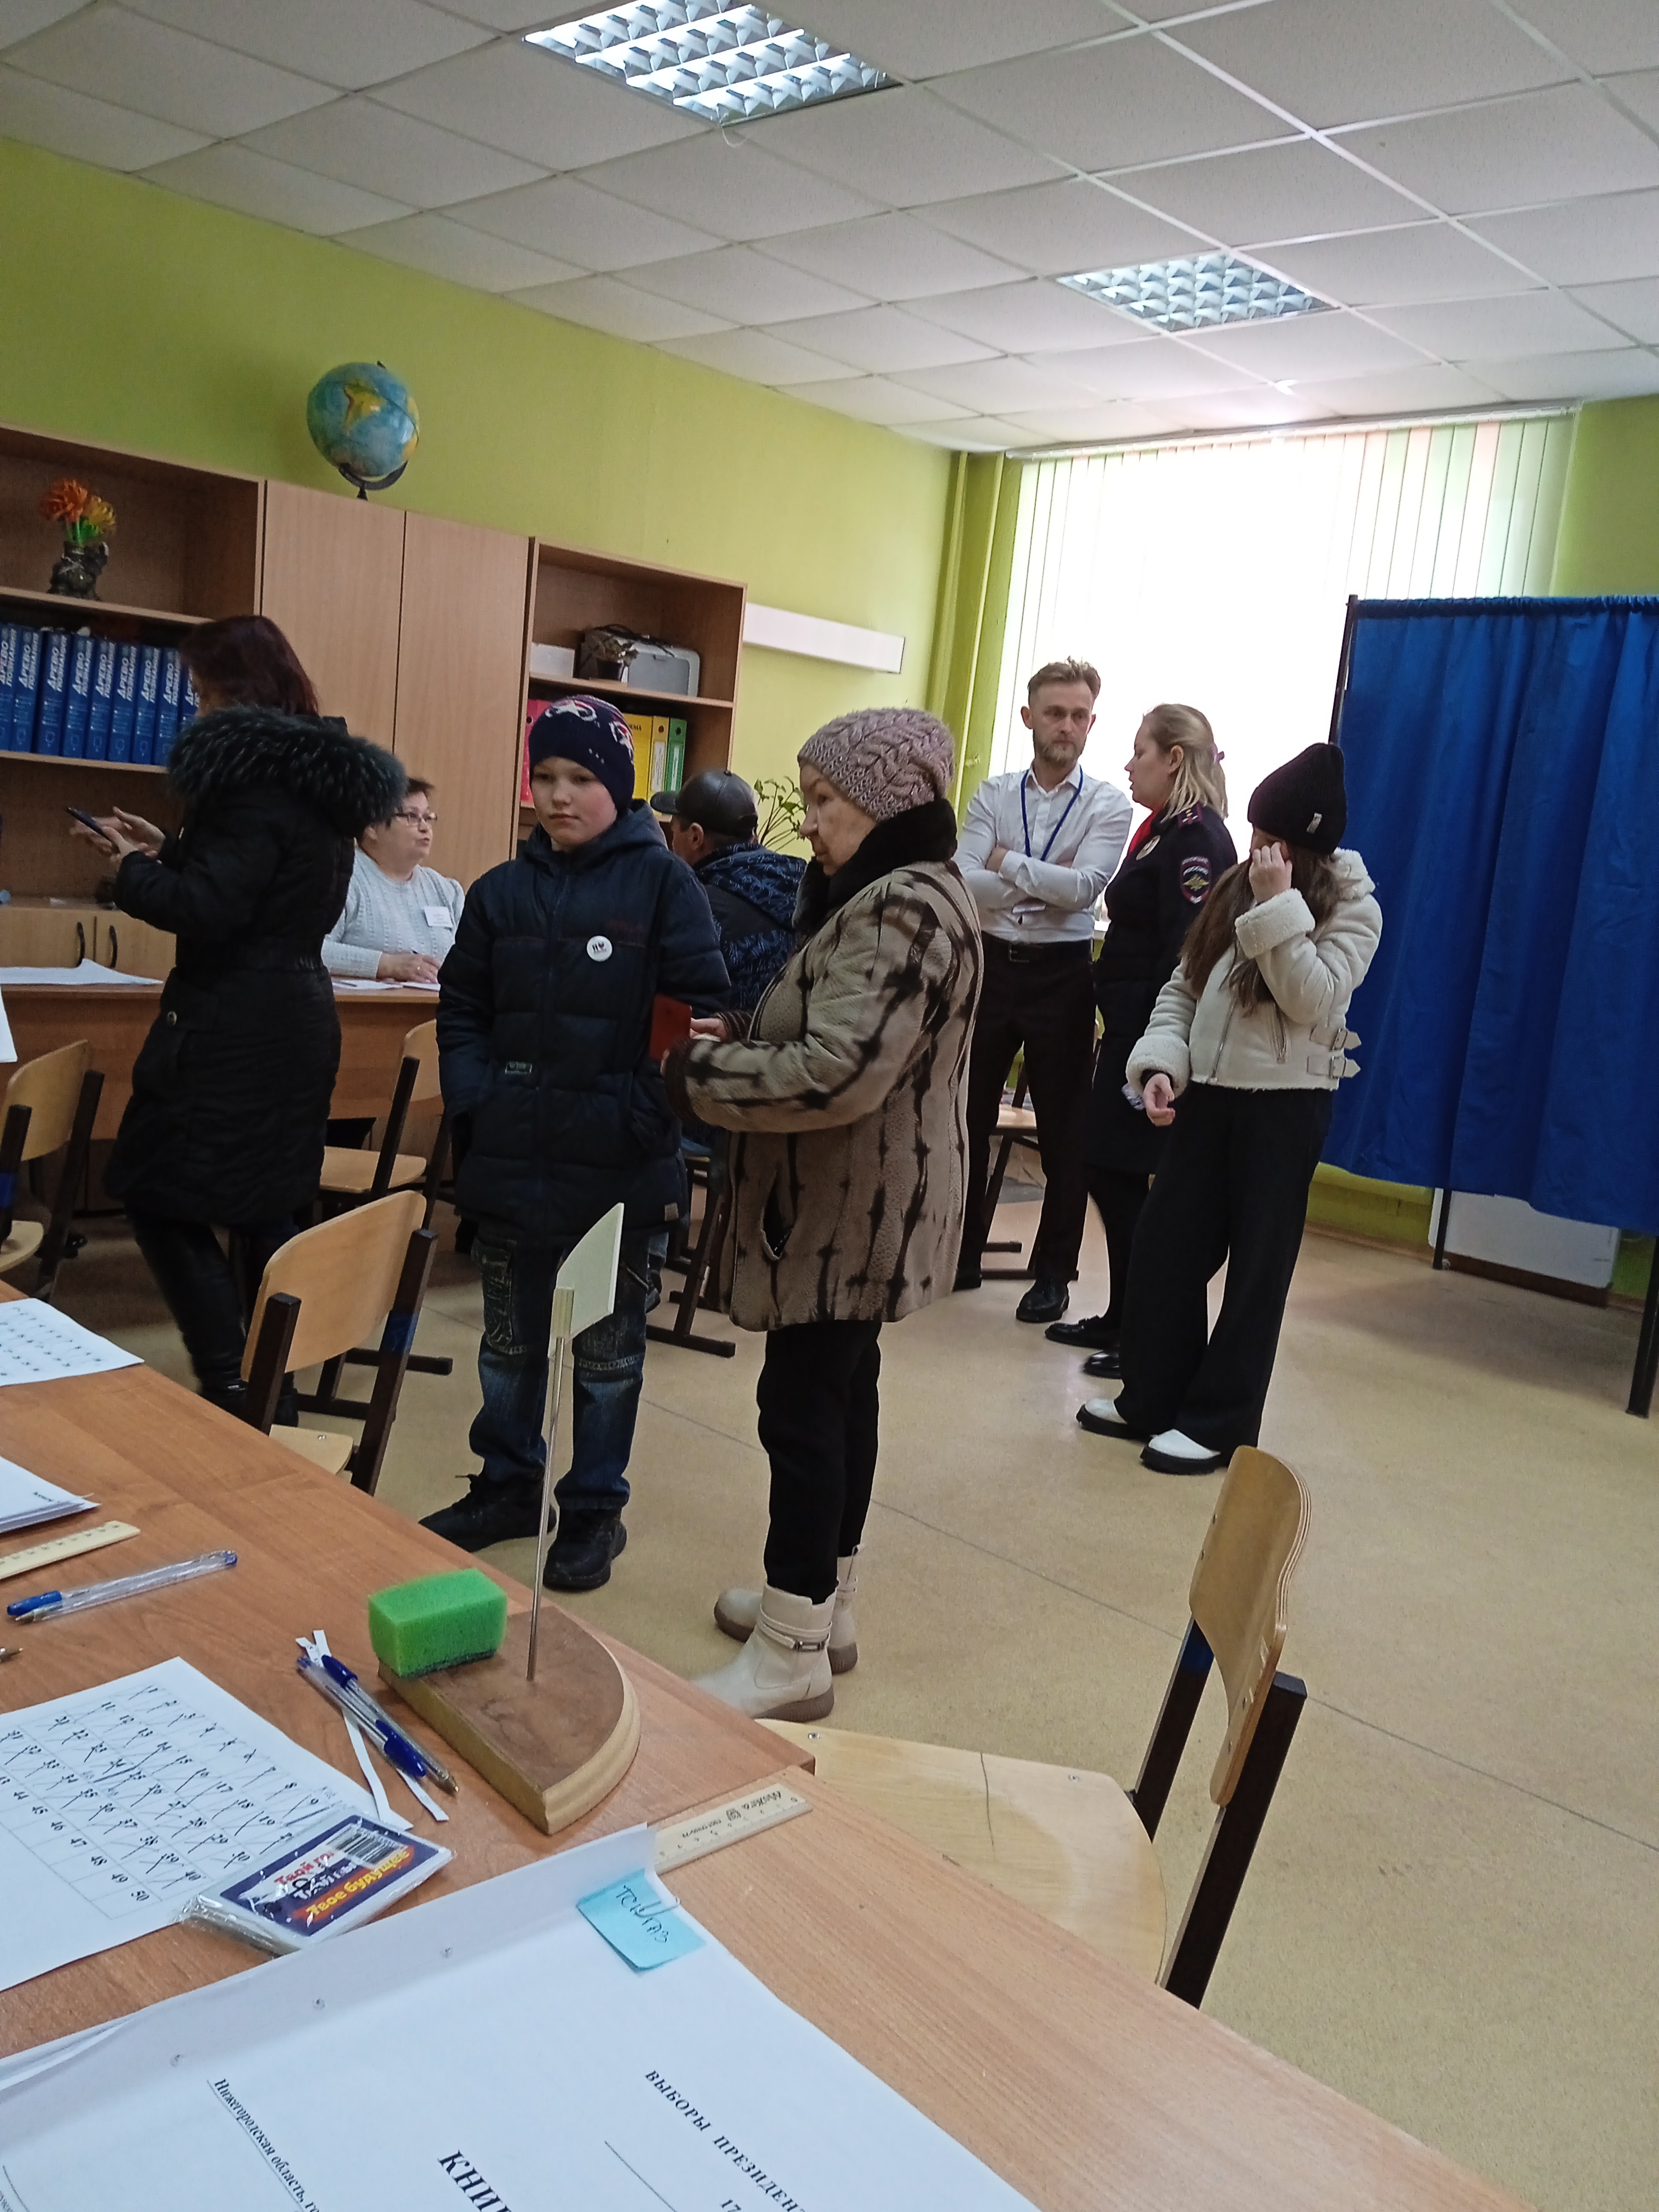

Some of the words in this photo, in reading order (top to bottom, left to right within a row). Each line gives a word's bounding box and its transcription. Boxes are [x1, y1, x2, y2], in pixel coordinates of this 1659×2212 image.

[306, 1890, 347, 1915] Твое
[645, 2070, 711, 2132] ВЫБОРЫ
[214, 2079, 275, 2156] Нижегородская
[271, 2156, 305, 2202] область,
